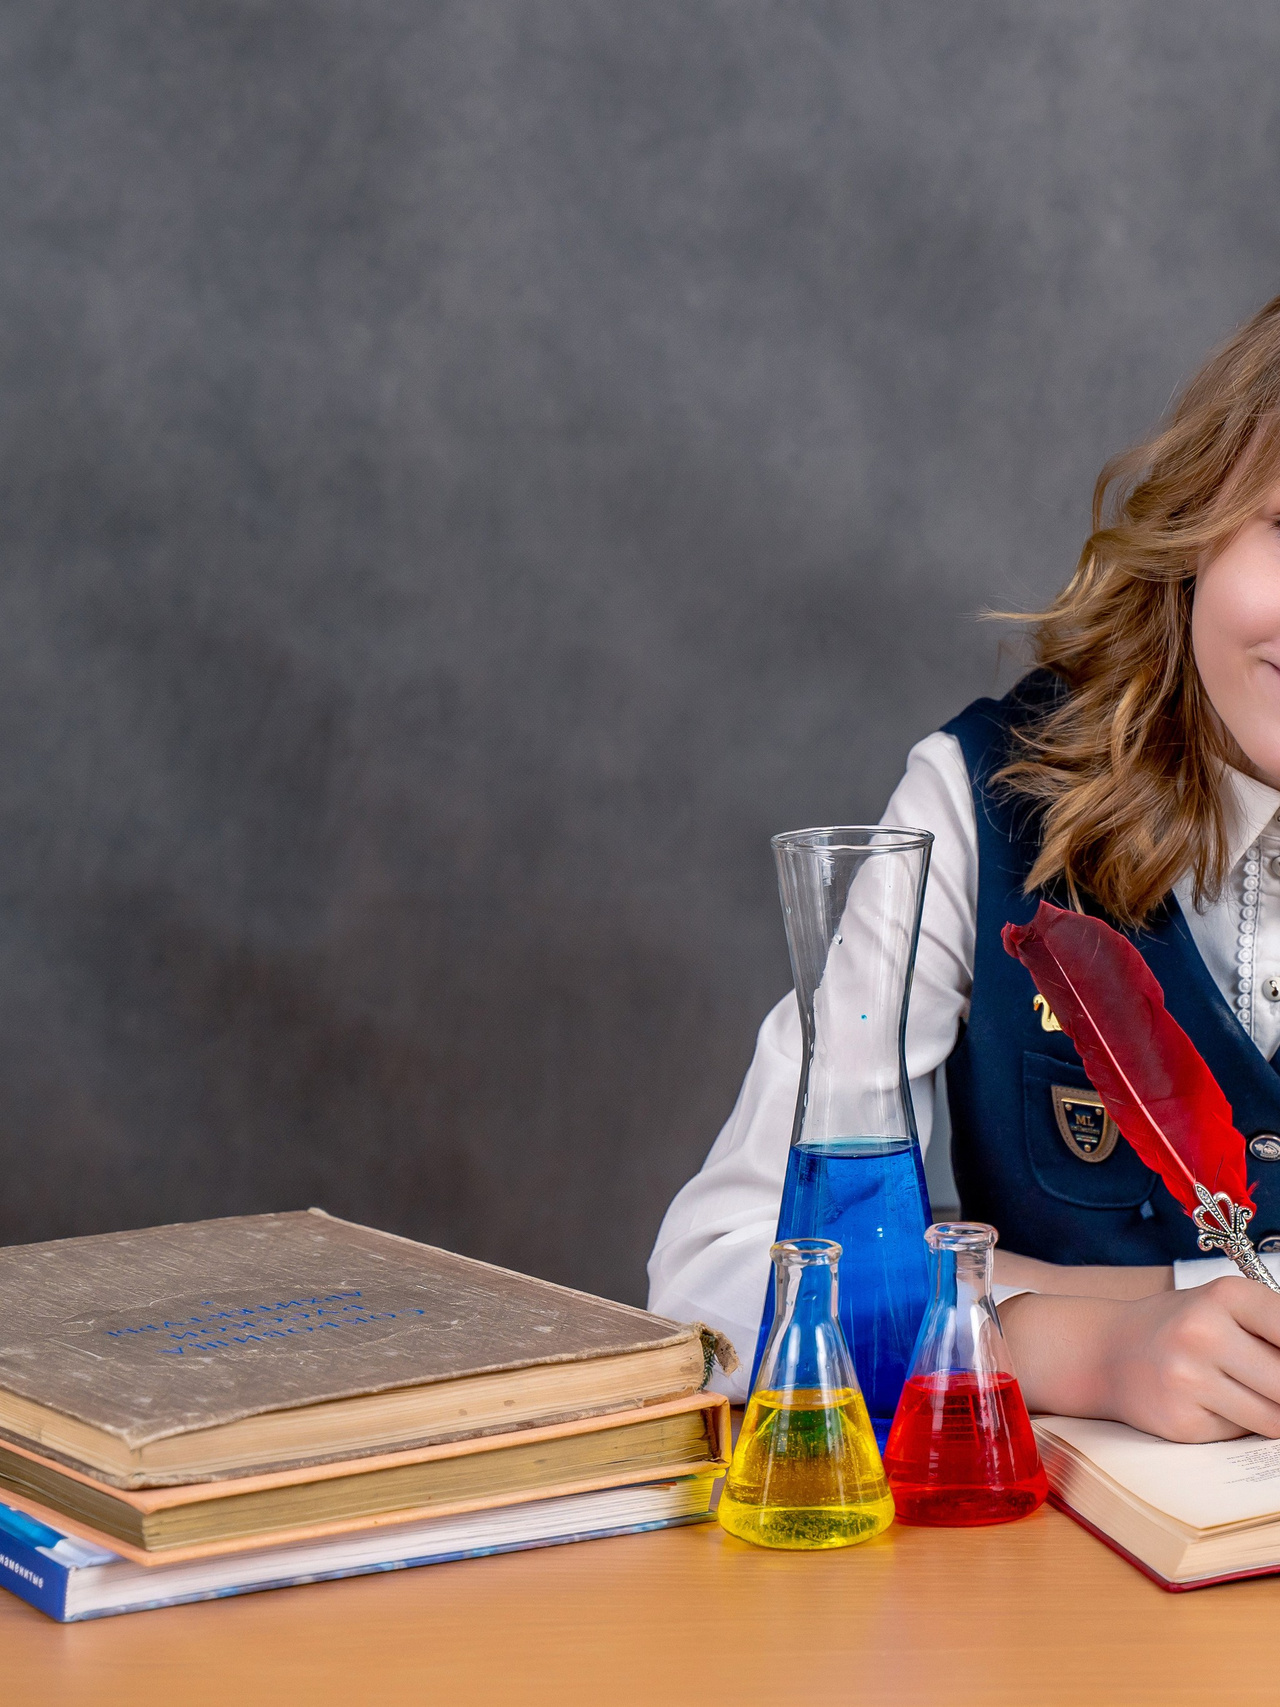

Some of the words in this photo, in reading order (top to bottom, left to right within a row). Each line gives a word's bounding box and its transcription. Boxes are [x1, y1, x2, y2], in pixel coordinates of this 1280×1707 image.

[1075, 1114, 1095, 1126] ML
[106, 1291, 362, 1337] АРХИТЕКТУРЫ
[155, 1308, 426, 1354] СОКРОВИЩА
[170, 1304, 365, 1340] РУССКОЙ
